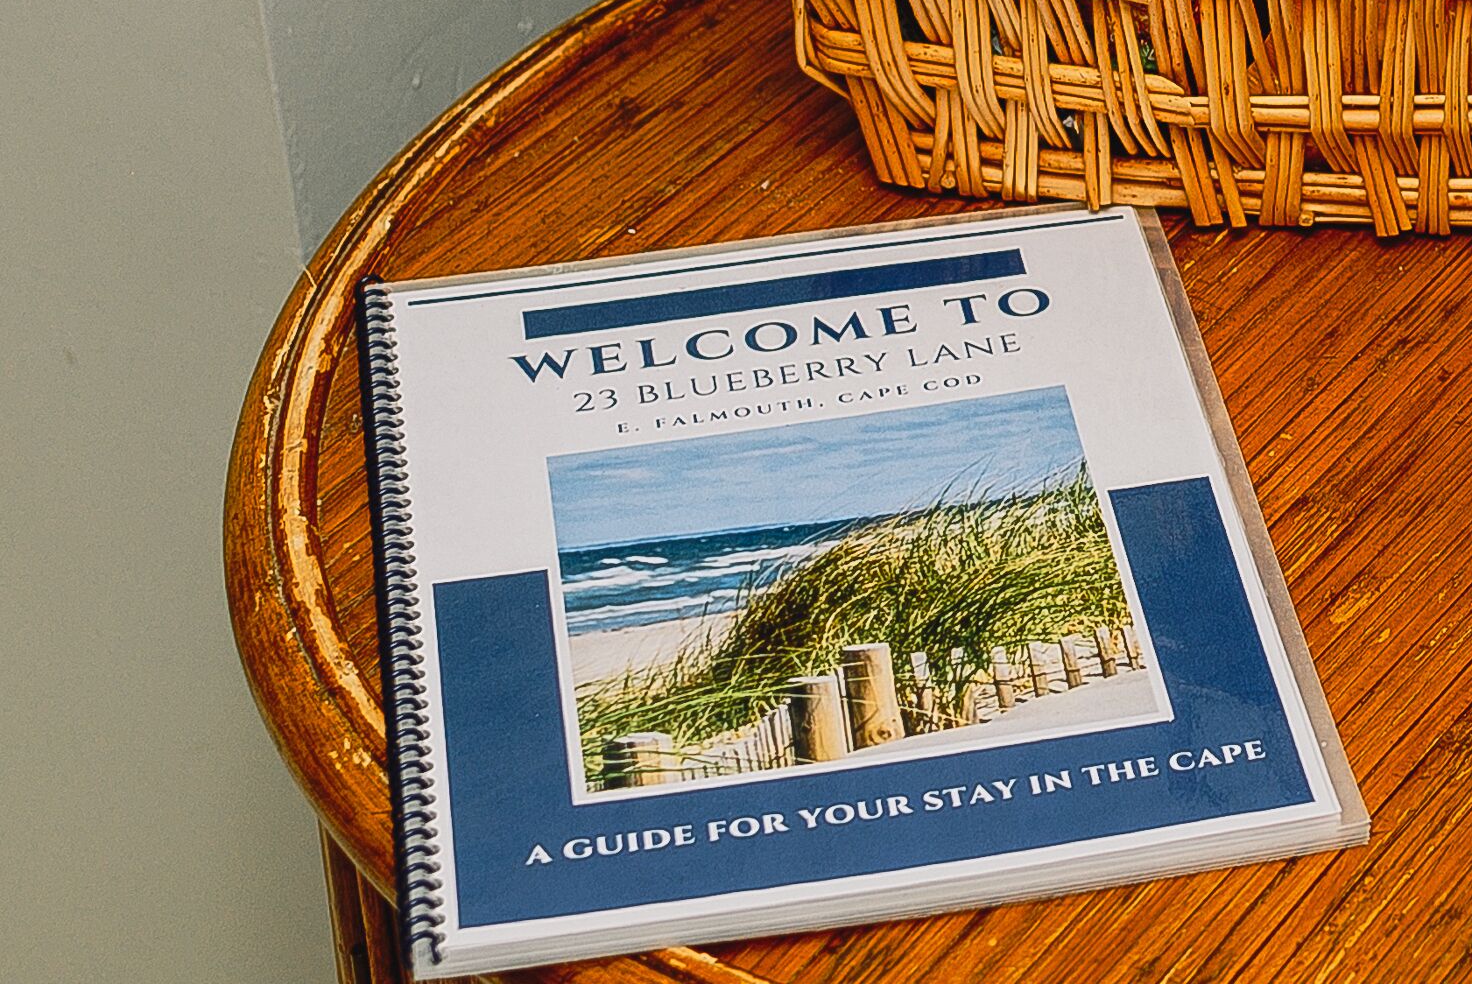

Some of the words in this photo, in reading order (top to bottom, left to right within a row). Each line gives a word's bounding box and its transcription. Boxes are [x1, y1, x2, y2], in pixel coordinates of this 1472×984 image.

[509, 305, 918, 384] WELCOME
[942, 288, 1051, 327] TO
[573, 389, 619, 413] 23
[638, 352, 888, 404] BLUEBERRY
[908, 333, 1021, 369] LANE
[617, 421, 641, 434] E.
[838, 384, 909, 405] CAPE
[923, 374, 983, 392] COD
[525, 844, 553, 866] A
[563, 824, 696, 859] GUIDE
[707, 813, 790, 843] FOR
[798, 796, 914, 829] YOUR
[922, 778, 1017, 811] STAY
[1029, 770, 1072, 795] IN
[1081, 756, 1160, 786] THE
[1168, 740, 1267, 772] CAPE
